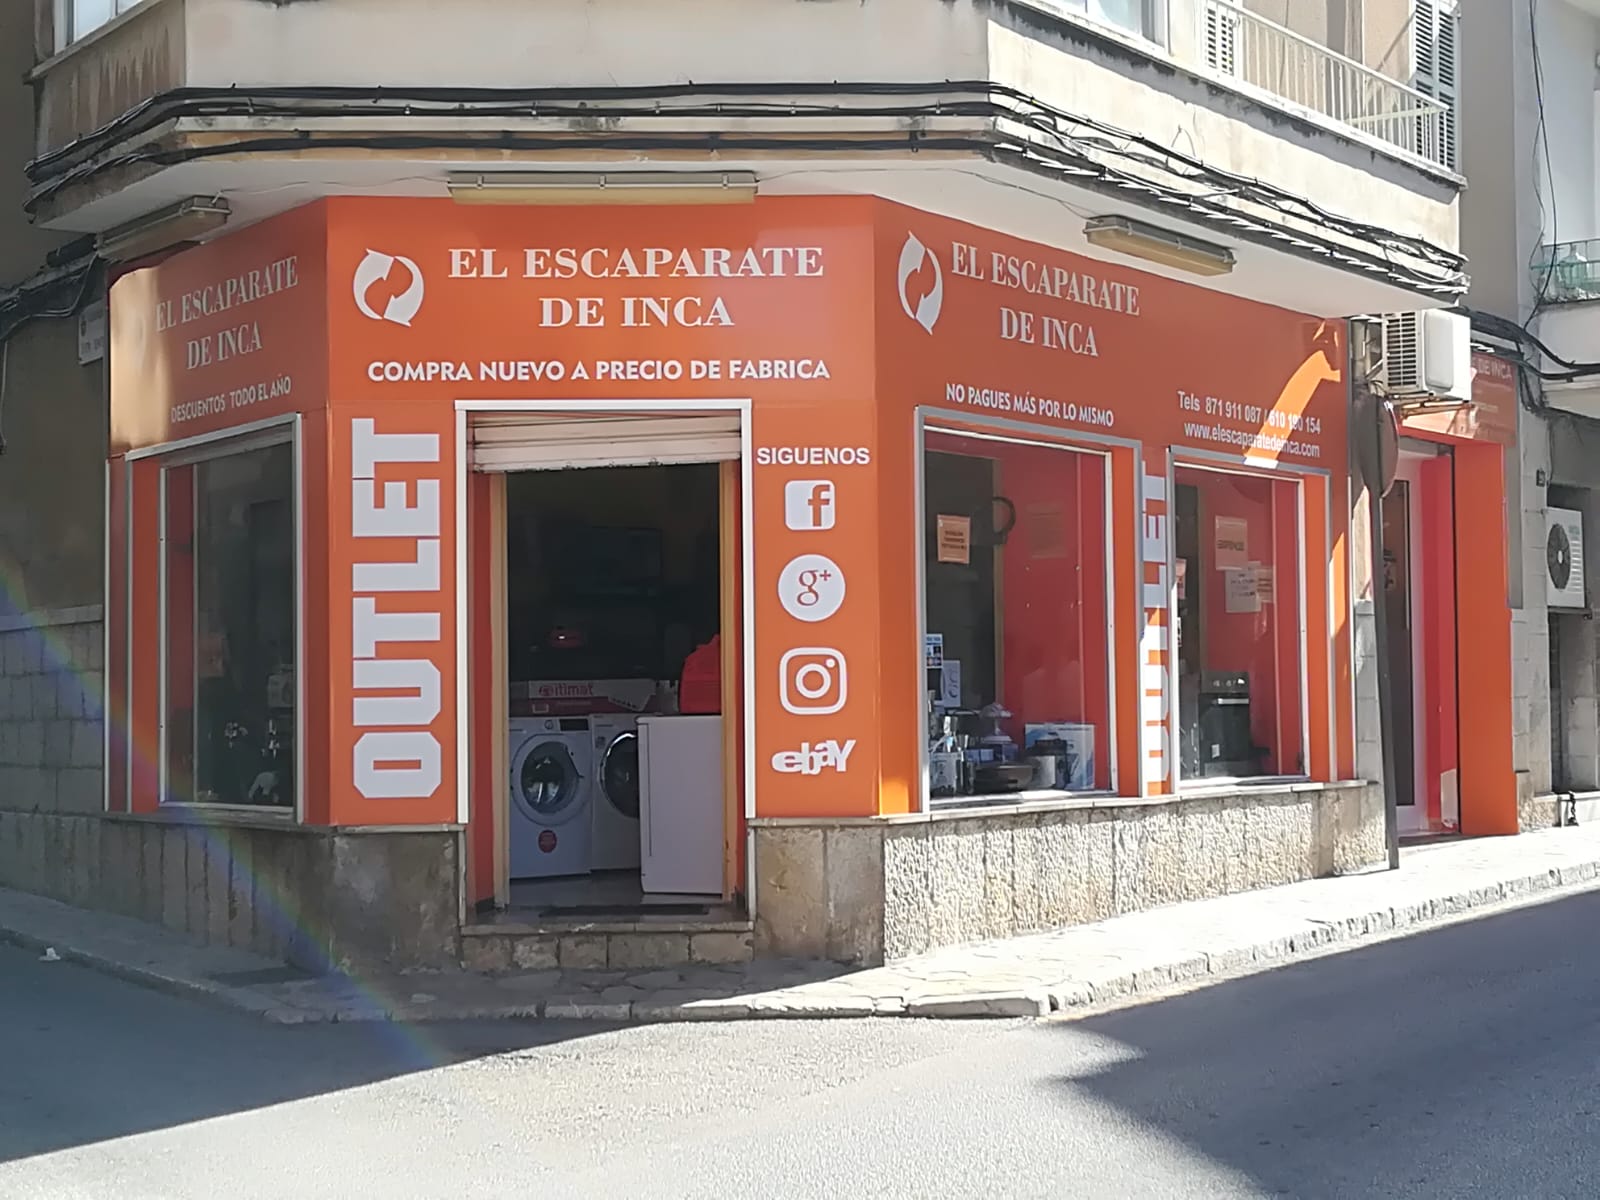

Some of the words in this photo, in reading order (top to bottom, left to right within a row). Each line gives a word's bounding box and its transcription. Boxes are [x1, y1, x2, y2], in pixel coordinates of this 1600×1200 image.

[449, 247, 507, 279] EL
[523, 246, 825, 279] ESCAPARATE
[952, 241, 984, 280] EL
[991, 252, 1140, 316] ESCAPARATE
[156, 300, 176, 332] EL
[181, 255, 298, 324] ESCAPARATE
[539, 297, 605, 328] DE
[621, 296, 736, 328] INCA
[187, 336, 212, 370] DE
[217, 321, 262, 361] INCA
[1000, 307, 1035, 344] DE
[1041, 315, 1098, 357] INCA
[367, 361, 473, 382] COMPRA
[479, 360, 565, 382] NUEVO
[570, 361, 590, 381] A
[595, 359, 684, 381] PRECIO
[690, 359, 722, 380] DE
[728, 358, 831, 381] FABRICA
[171, 394, 226, 423] DESCUENTOS
[229, 385, 256, 408] TODO
[257, 383, 268, 401] EL
[946, 383, 965, 403] NO
[968, 386, 1011, 411] PAGUES
[1013, 391, 1036, 415] MÁS
[1039, 398, 1060, 418] POR
[1063, 402, 1077, 421] LO
[1078, 405, 1114, 427] MISMO
[1177, 390, 1201, 411] Tels
[1205, 396, 1223, 416] 871
[1225, 401, 1242, 420] 911
[1268, 409, 1285, 428] 610
[1305, 417, 1321, 434] 154
[756, 446, 871, 466] SIGUENOS
[1184, 422, 1320, 458] www.elescaparatedeinca.com
[352, 417, 442, 799] OUTLET
